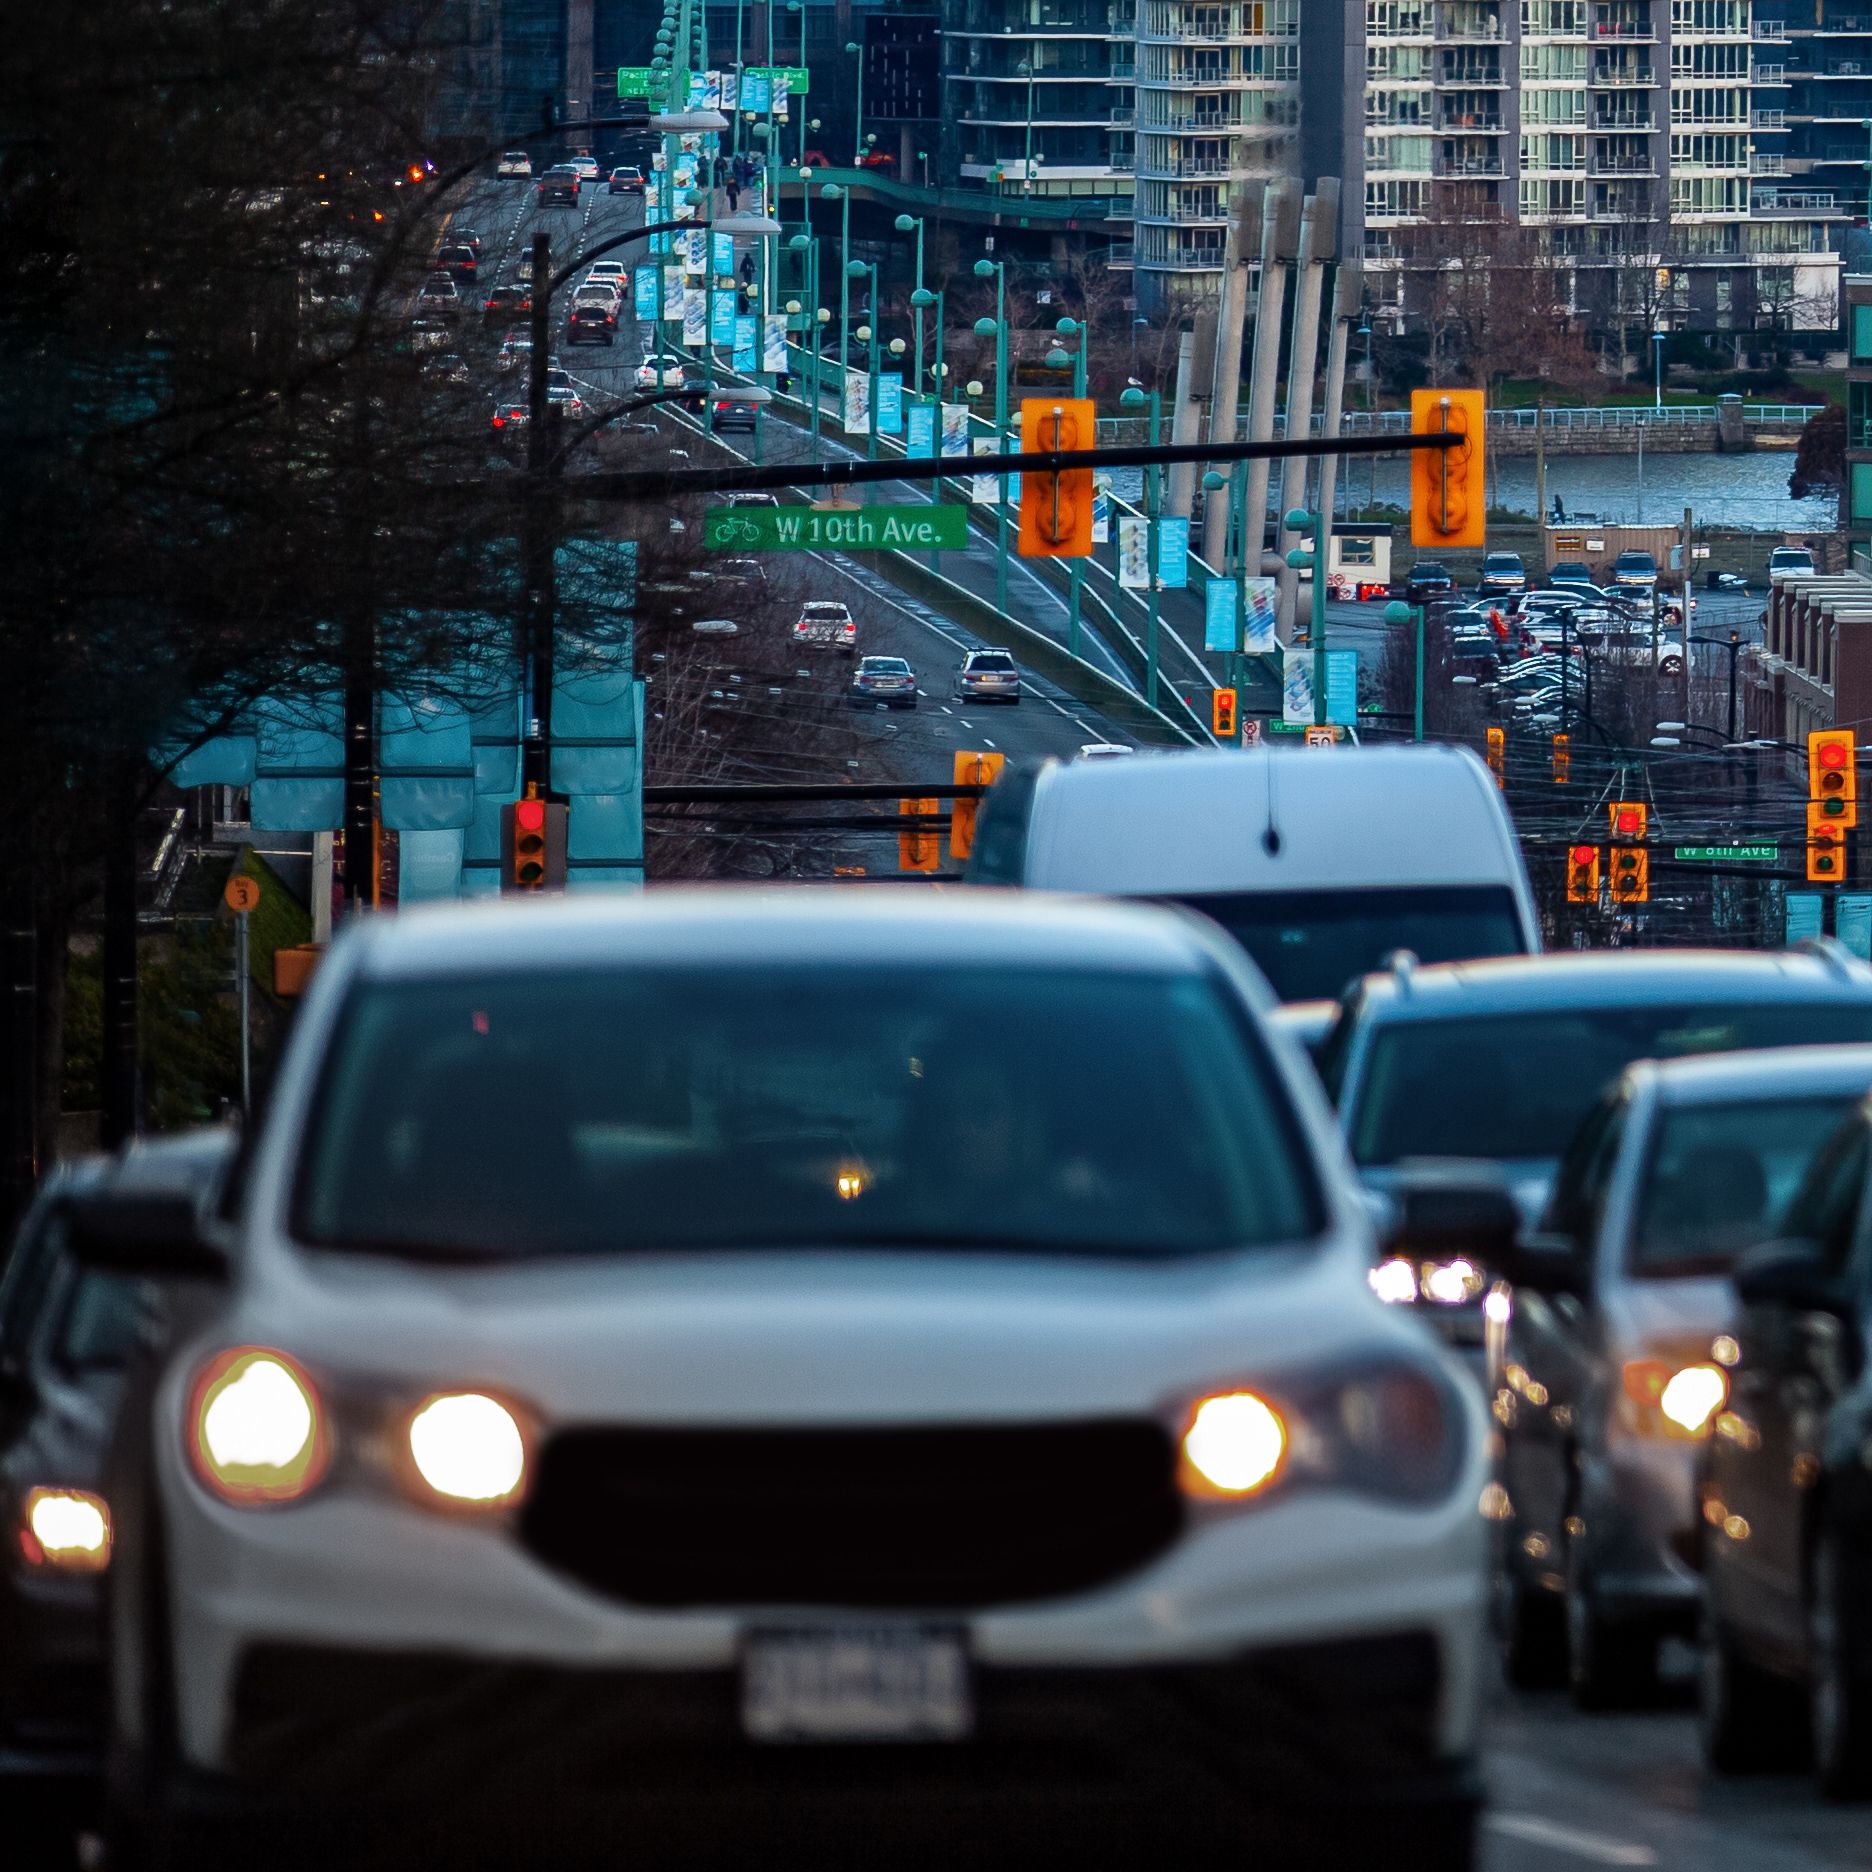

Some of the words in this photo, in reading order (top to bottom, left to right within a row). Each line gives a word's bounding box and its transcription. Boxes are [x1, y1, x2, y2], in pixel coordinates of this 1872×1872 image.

[775, 516, 801, 543] W
[807, 514, 873, 543] 10th
[881, 516, 942, 543] Ave.
[1683, 847, 1696, 856] W
[1740, 847, 1770, 856] Ave
[236, 888, 248, 906] 3
